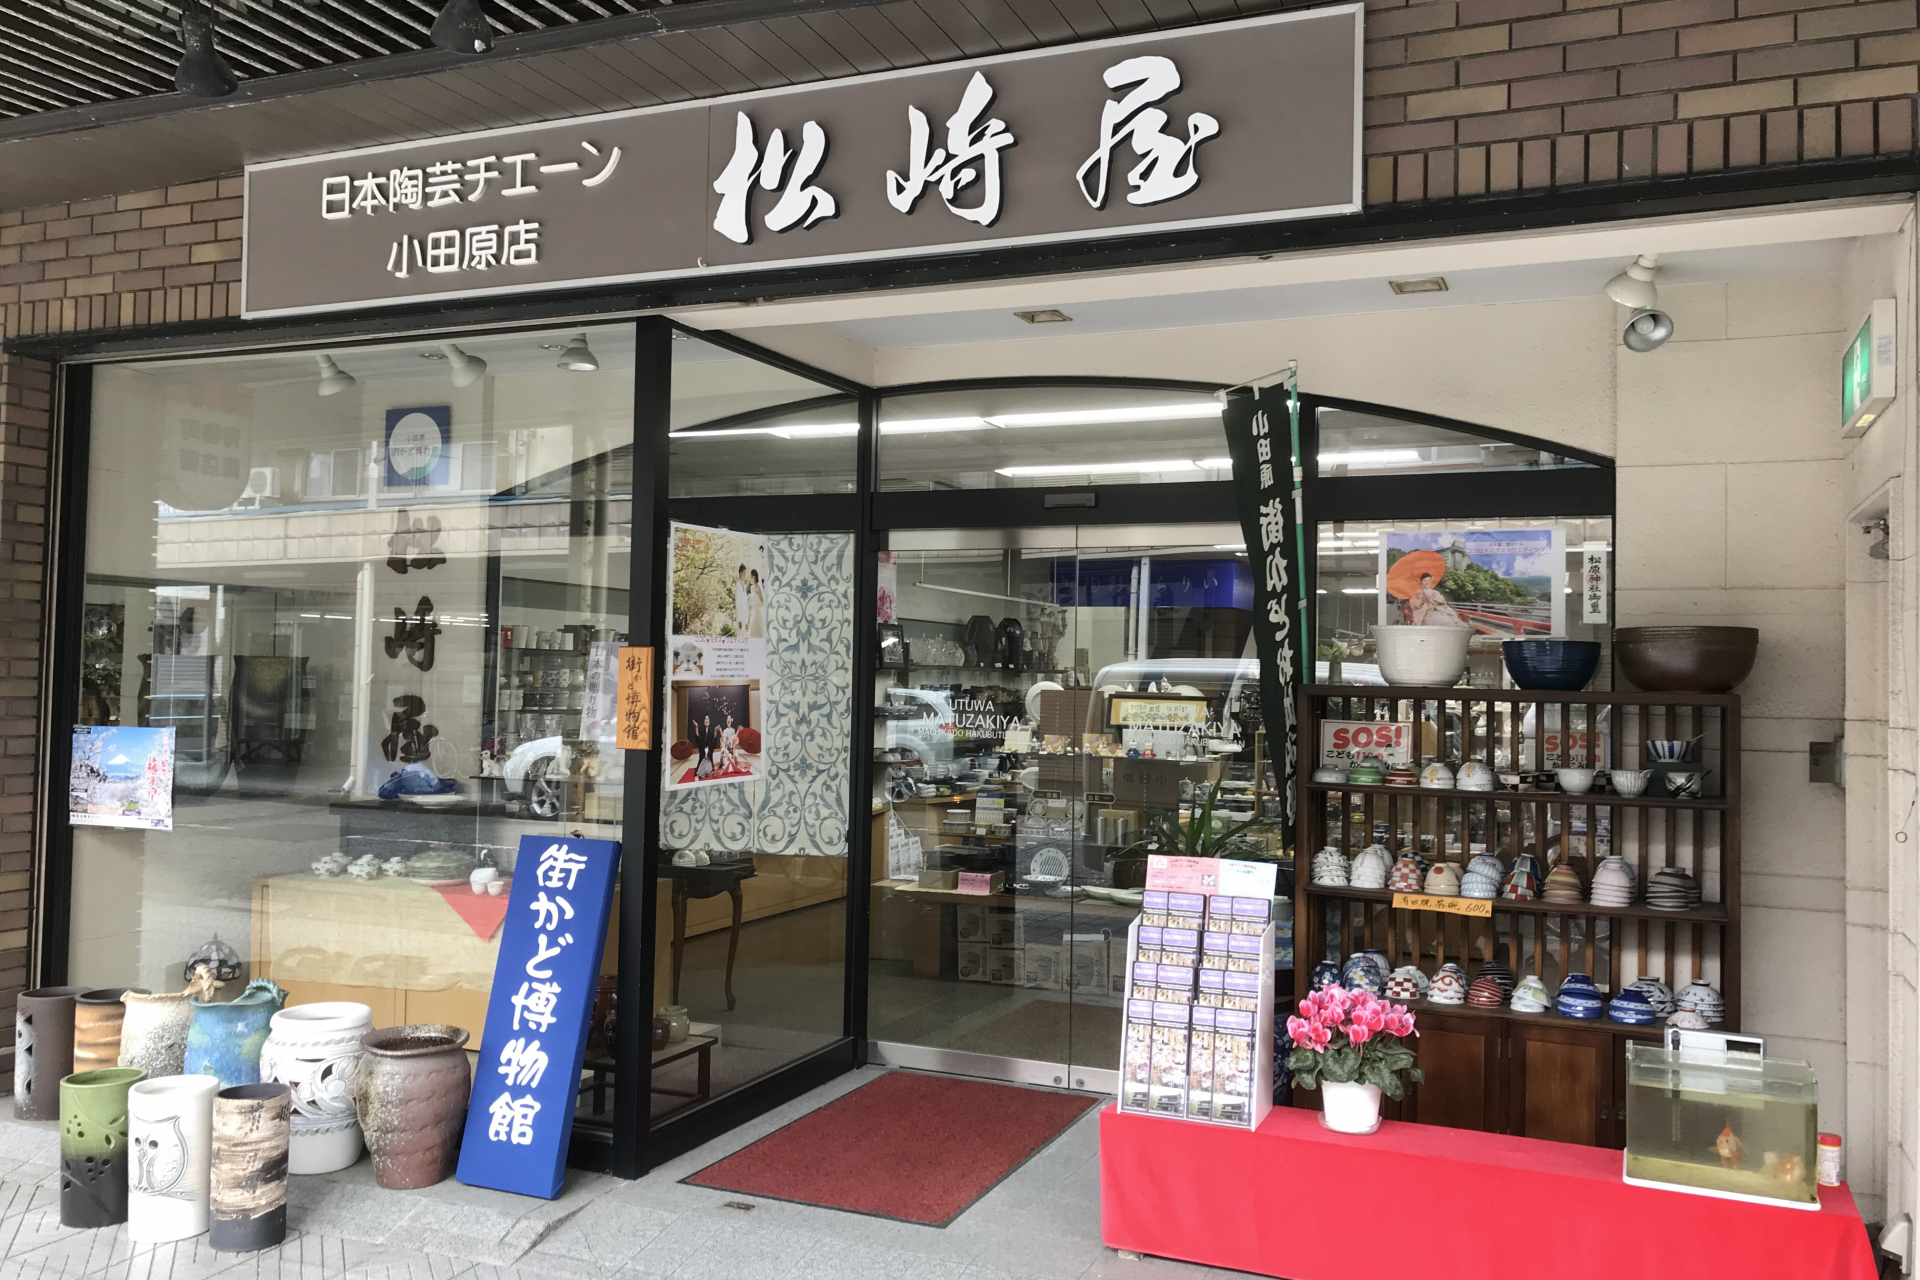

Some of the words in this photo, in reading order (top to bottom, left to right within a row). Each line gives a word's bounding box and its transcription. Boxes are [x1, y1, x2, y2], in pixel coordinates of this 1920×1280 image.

[387, 219, 540, 278] 小田原店
[586, 645, 604, 719] 日本の贈り物
[949, 699, 994, 712] UTUWA
[922, 711, 1021, 730] MATUZAKIYA
[1333, 725, 1402, 749] SOS!
[1401, 896, 1432, 907] 有田焼
[488, 843, 588, 1146] 街かど博物館
